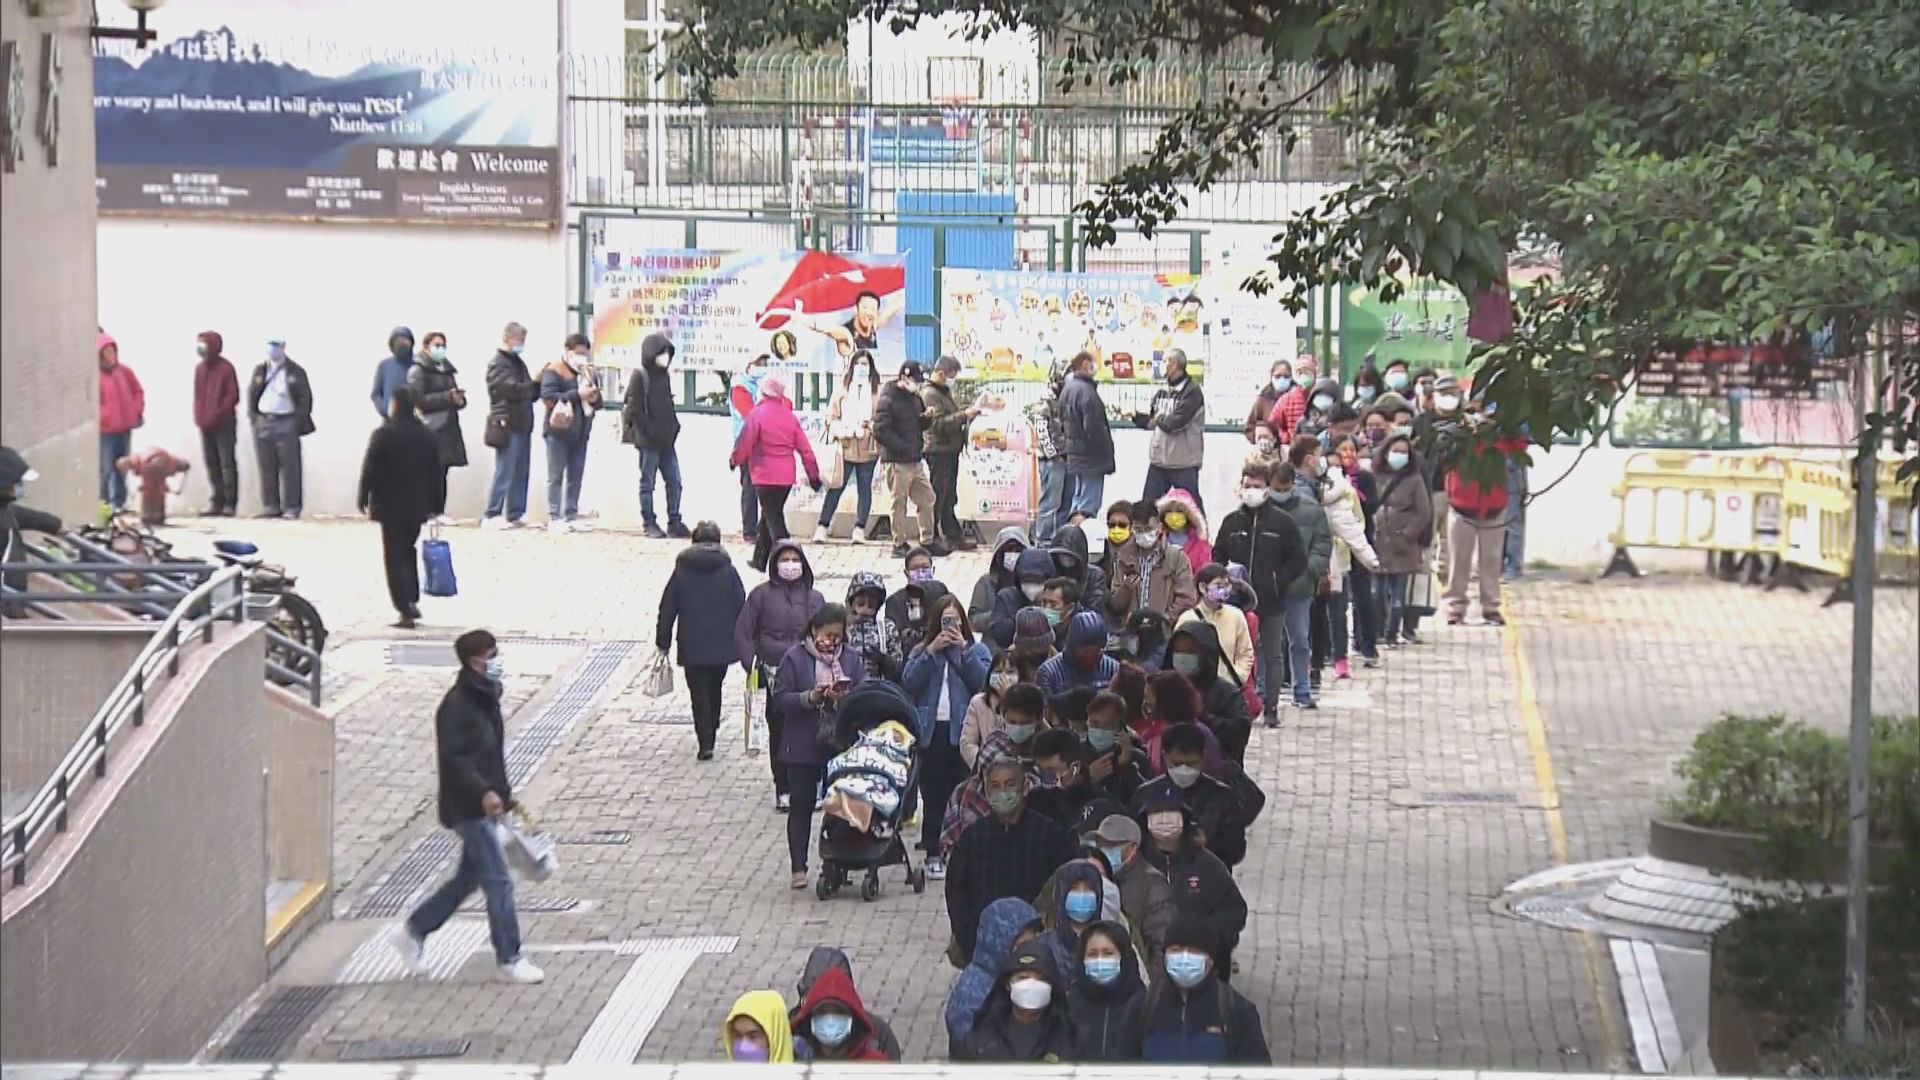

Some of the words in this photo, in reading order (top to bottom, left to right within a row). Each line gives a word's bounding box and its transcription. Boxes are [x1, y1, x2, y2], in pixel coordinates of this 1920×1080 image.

[113, 96, 150, 113] weary
[154, 95, 177, 110] and
[181, 94, 244, 113] burdened,
[247, 95, 272, 112] and
[274, 97, 281, 112] I
[283, 96, 306, 112] will
[308, 99, 336, 117] give
[337, 100, 362, 118] you
[330, 118, 386, 133] Matthew
[376, 148, 459, 173] 歡迎赴會
[471, 152, 549, 174] Welcome
[439, 181, 471, 195] English
[472, 183, 507, 195] Services
